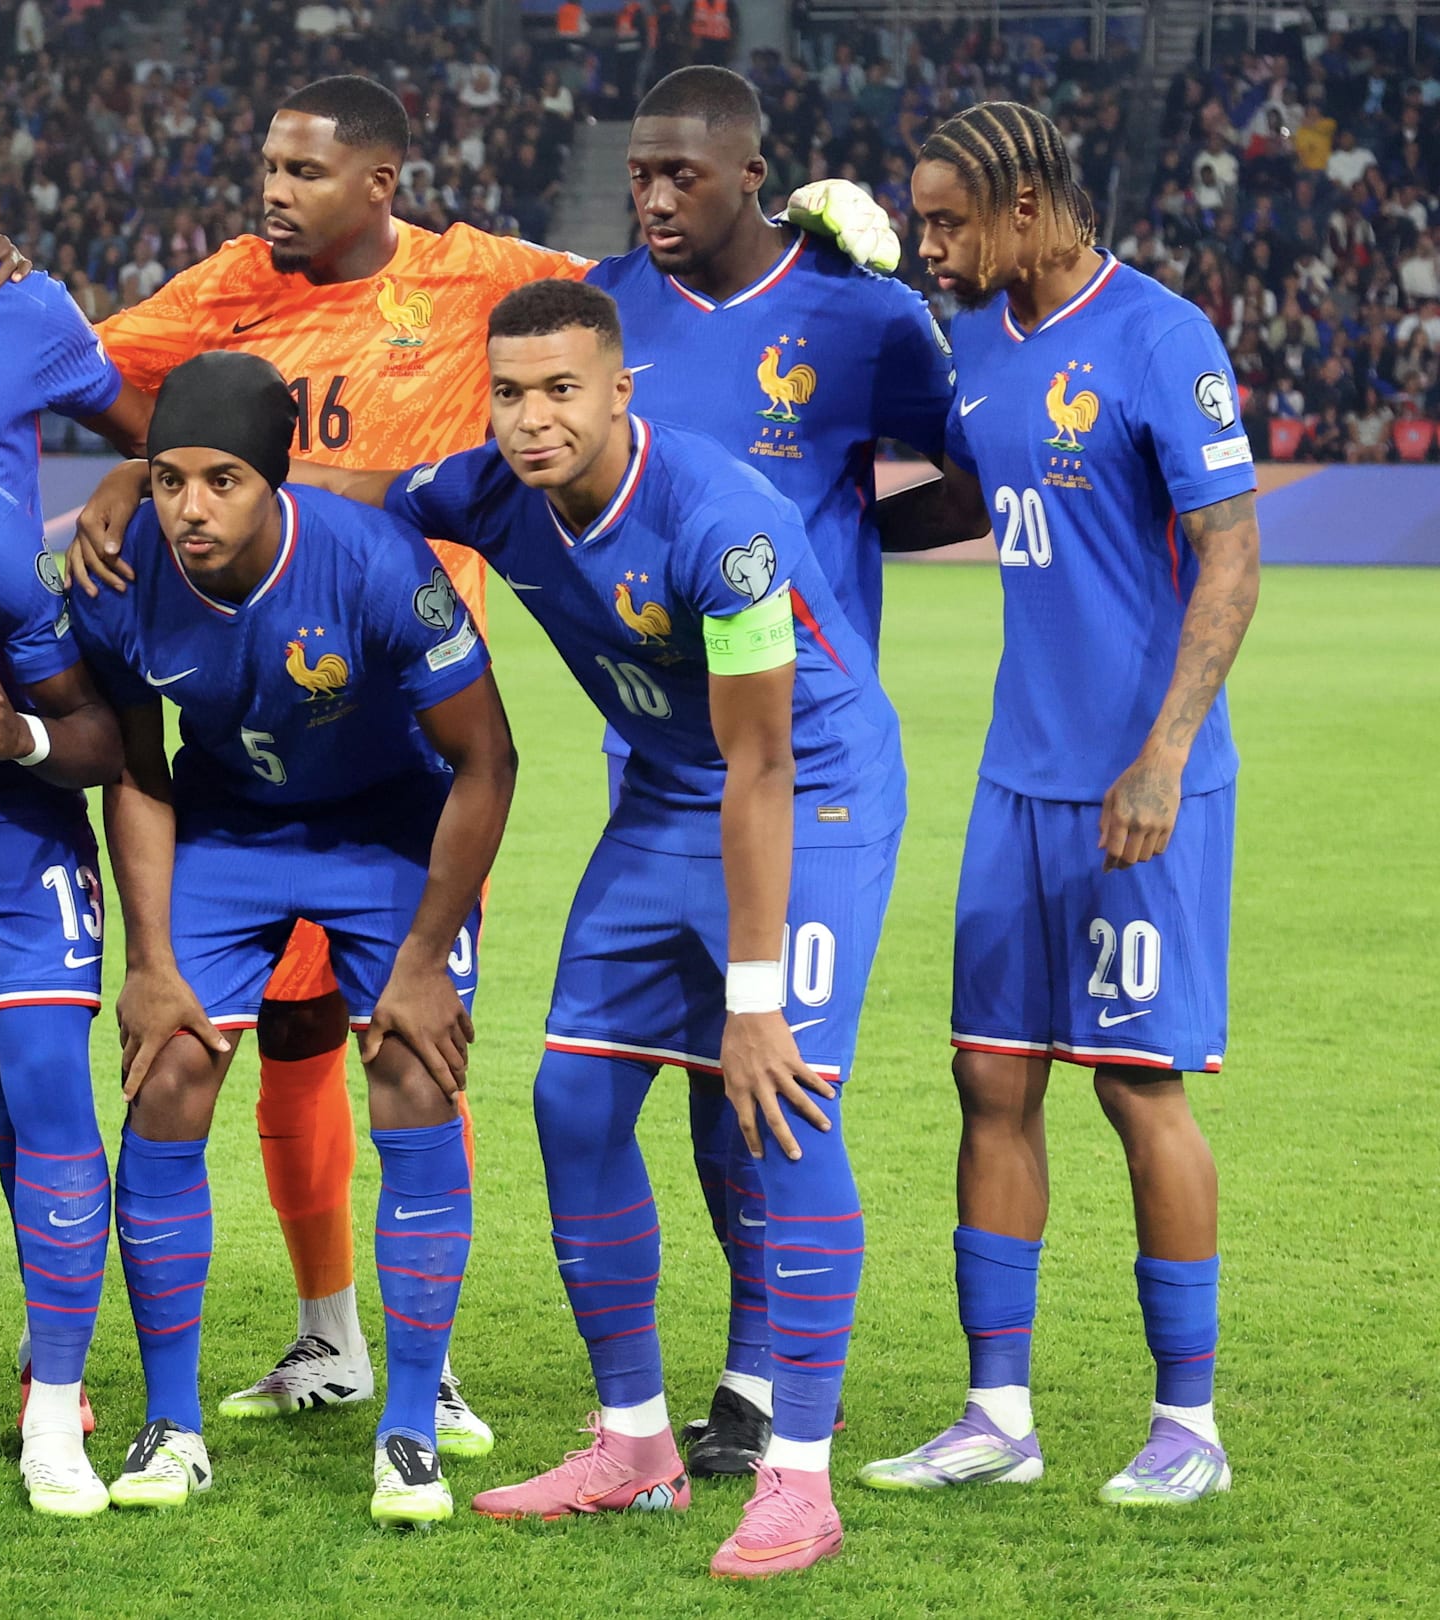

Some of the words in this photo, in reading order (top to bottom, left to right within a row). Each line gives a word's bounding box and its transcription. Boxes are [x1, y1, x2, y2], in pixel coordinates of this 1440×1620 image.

[287, 375, 353, 453] 16
[994, 485, 1053, 569] 20
[595, 654, 673, 720] 10
[240, 725, 288, 786] 5
[41, 865, 102, 942] 13
[1088, 917, 1162, 1002] 20
